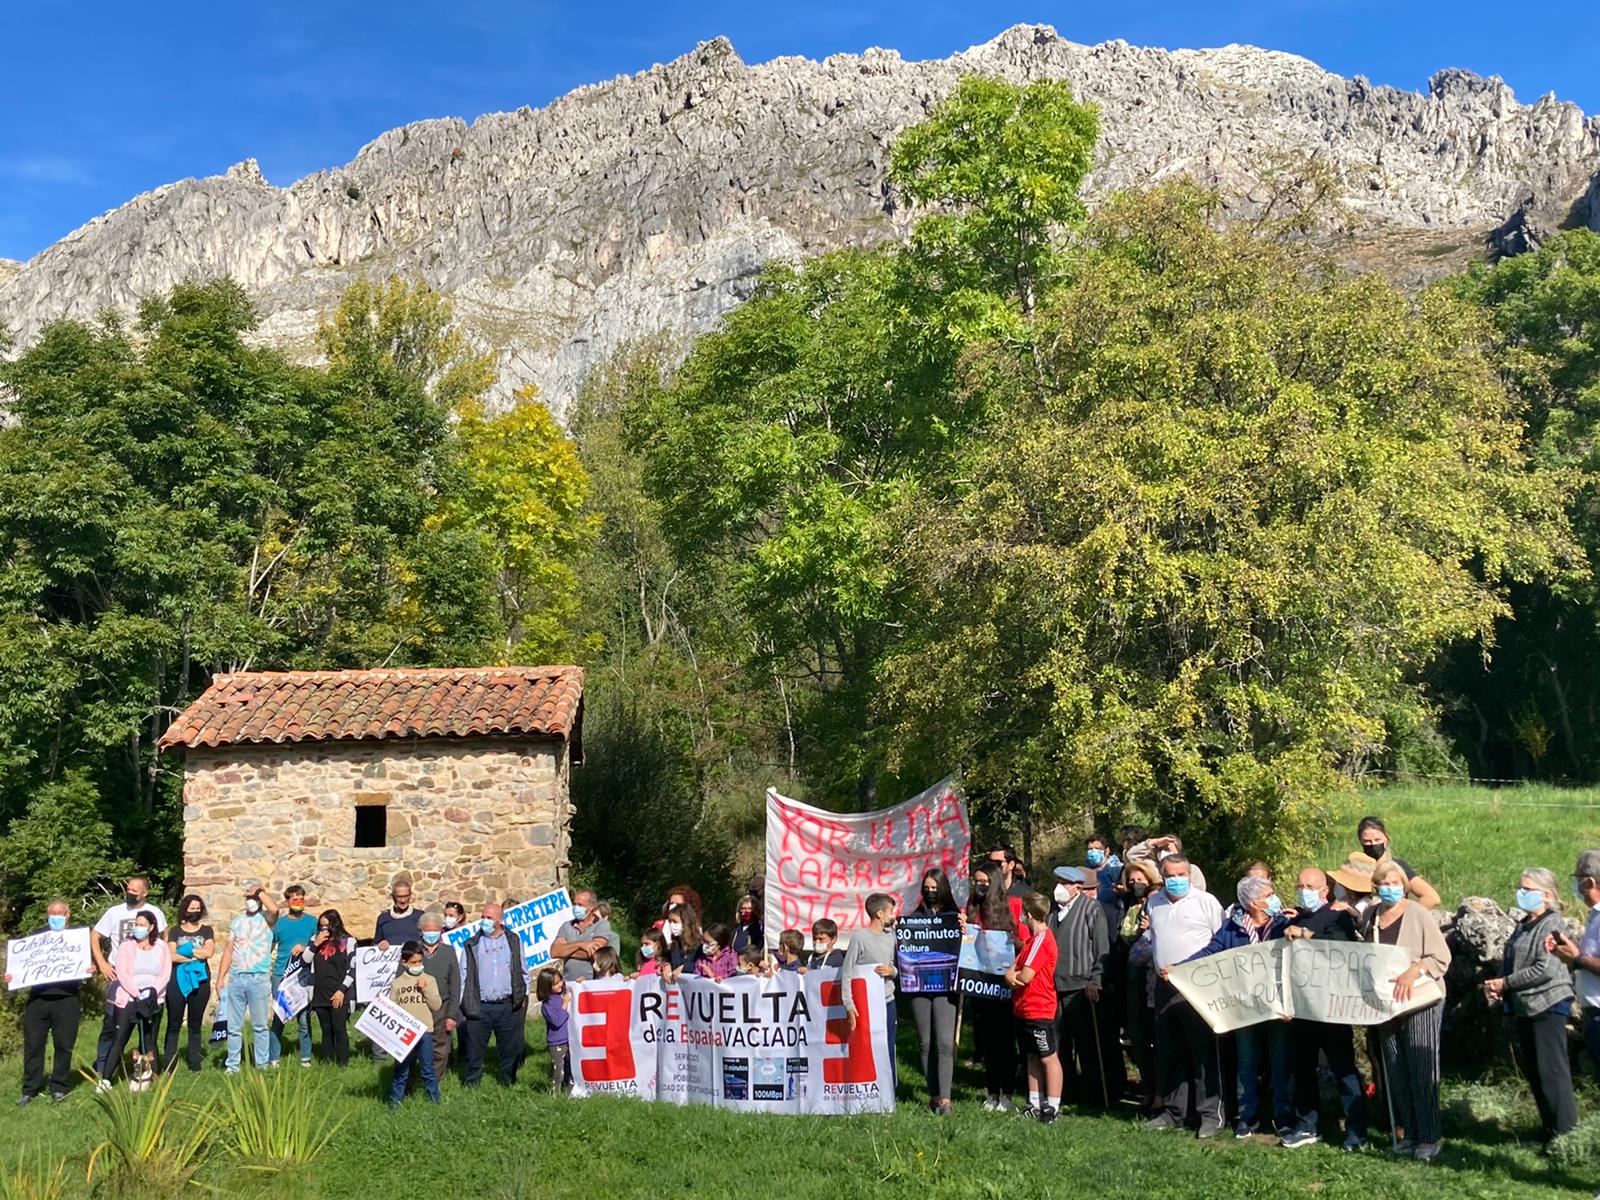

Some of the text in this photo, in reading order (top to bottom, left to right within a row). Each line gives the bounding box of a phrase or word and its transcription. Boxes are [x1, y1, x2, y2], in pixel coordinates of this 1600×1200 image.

[503, 890, 570, 929] CARRETERA
[896, 928, 911, 940] 30
[915, 928, 959, 940] minutos
[899, 944, 929, 953] Cultura
[959, 978, 1012, 1000] 100MBps
[640, 990, 812, 1024] REVUELTA
[585, 1080, 638, 1091] REVUELTA
[824, 1083, 880, 1094] REVUELTA
[754, 1090, 782, 1099] 100MBps
